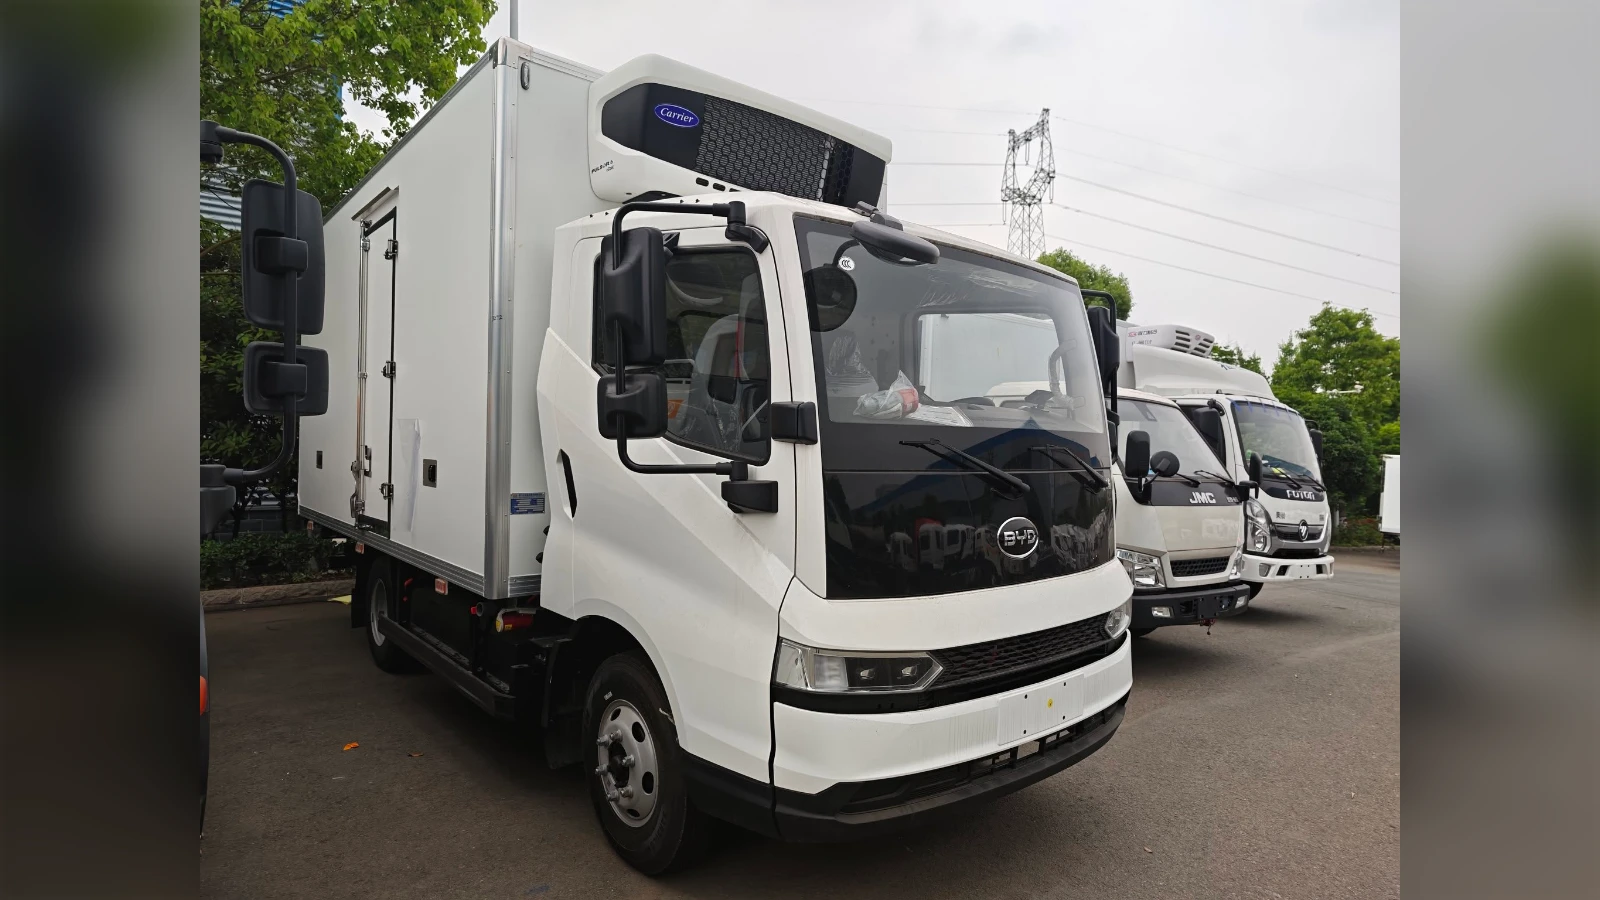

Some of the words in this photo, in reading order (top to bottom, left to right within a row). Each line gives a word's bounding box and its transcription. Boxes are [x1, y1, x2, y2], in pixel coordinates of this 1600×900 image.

[660, 107, 694, 123] Carrier
[1190, 491, 1217, 504] JMC
[1003, 529, 1036, 547] BYD
